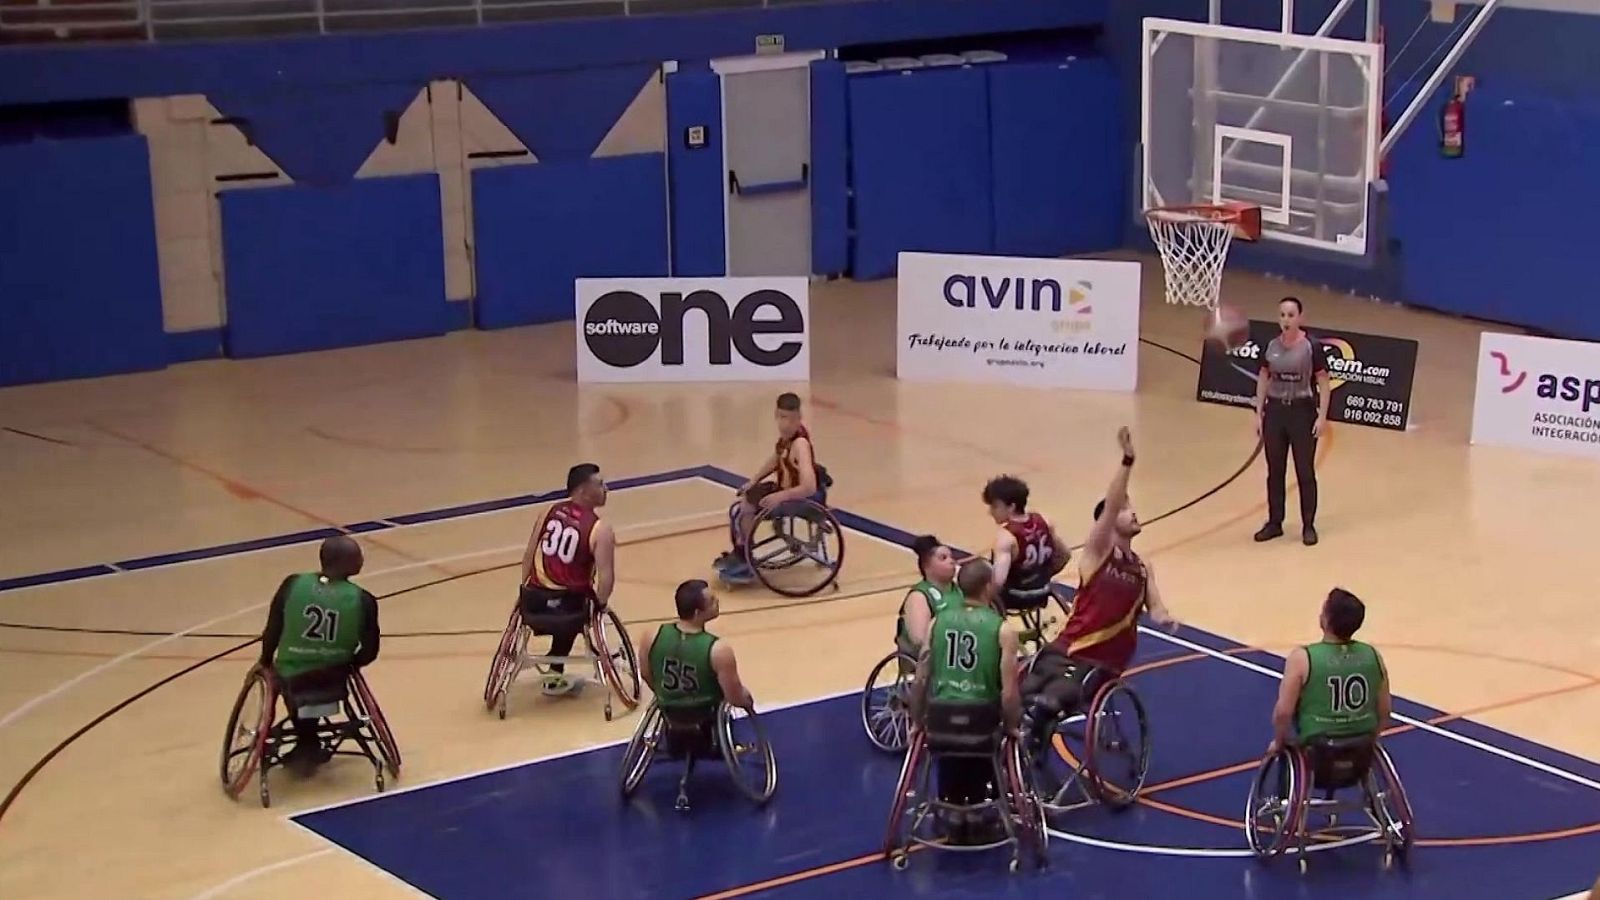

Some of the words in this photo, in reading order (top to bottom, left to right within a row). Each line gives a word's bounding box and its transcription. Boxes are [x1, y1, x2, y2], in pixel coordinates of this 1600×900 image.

[586, 319, 659, 335] software
[908, 333, 971, 351] Trabajando
[974, 340, 994, 353] por
[999, 337, 1010, 351] la
[1083, 342, 1126, 355] laboral
[1343, 408, 1362, 421] 916
[1363, 410, 1381, 424] 092
[1382, 413, 1401, 427] 858
[1346, 395, 1365, 408] 669
[1366, 397, 1385, 410] 783
[1386, 400, 1403, 413] 791
[542, 520, 579, 564] 30
[302, 604, 339, 642] 21
[945, 629, 978, 672] 13
[662, 656, 700, 694] 55
[1328, 673, 1369, 713] 10
